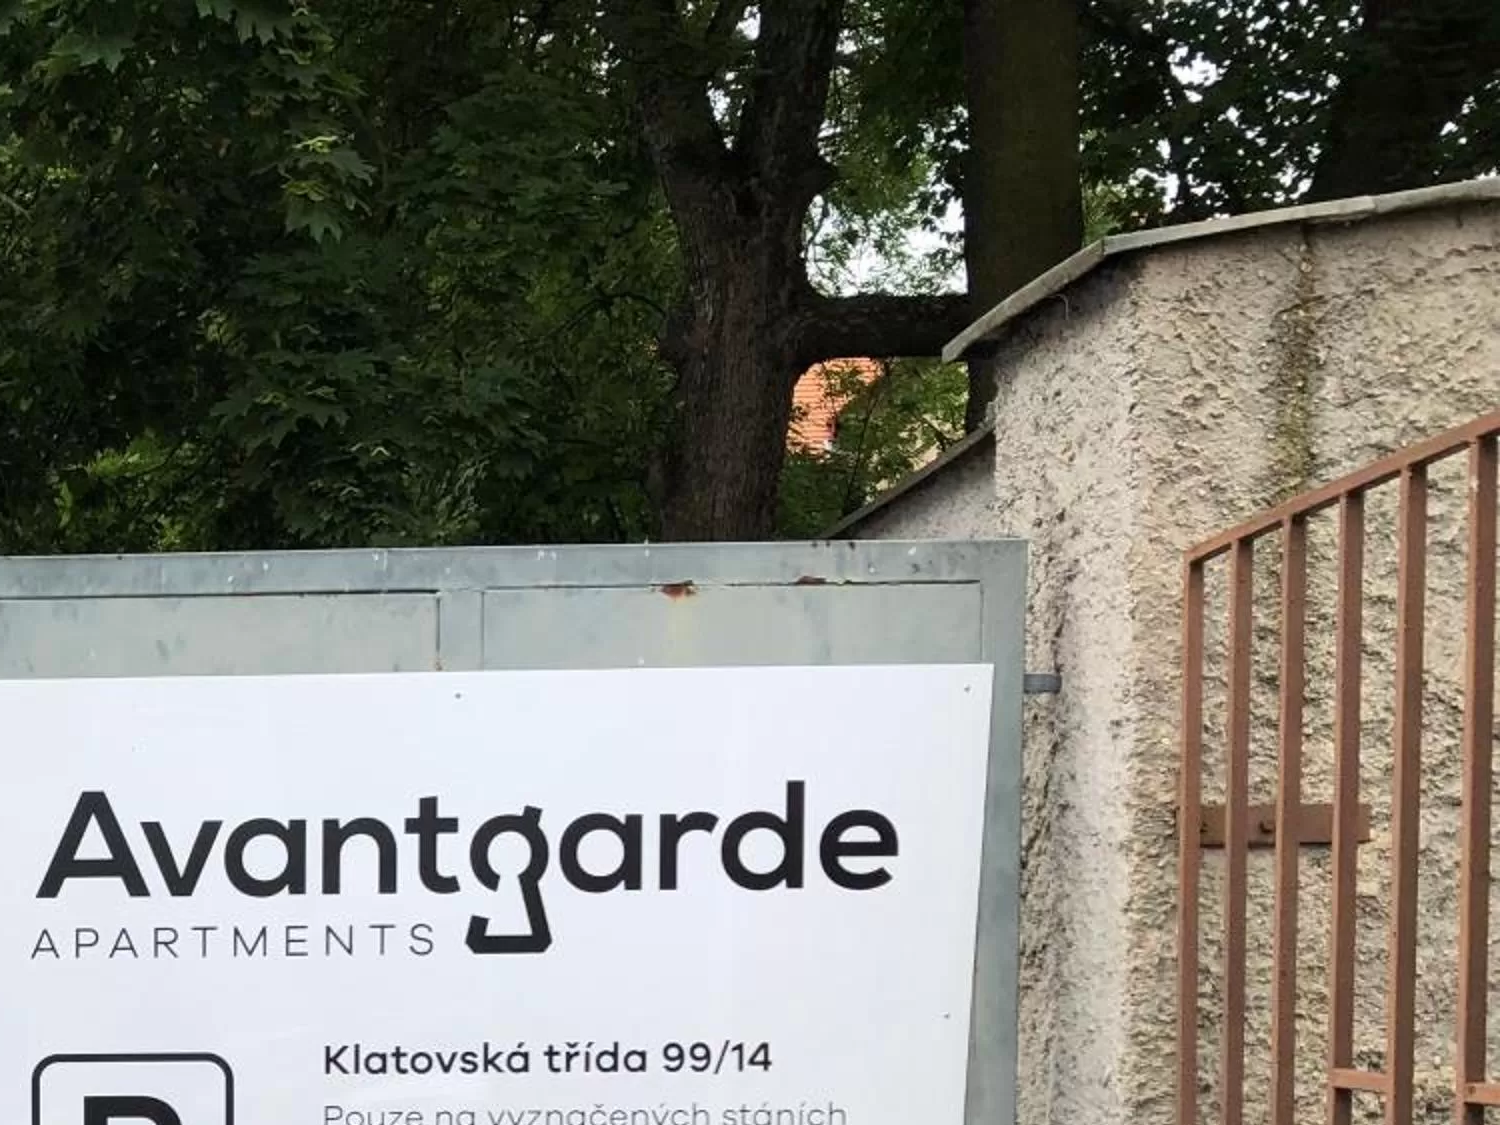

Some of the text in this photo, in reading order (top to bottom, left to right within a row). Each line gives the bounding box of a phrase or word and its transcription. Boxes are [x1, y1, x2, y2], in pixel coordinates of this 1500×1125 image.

[35, 779, 900, 956] Avantgarde
[30, 923, 435, 960] APARTMENTS
[323, 1039, 774, 1076] Klatovská třída 99/14
